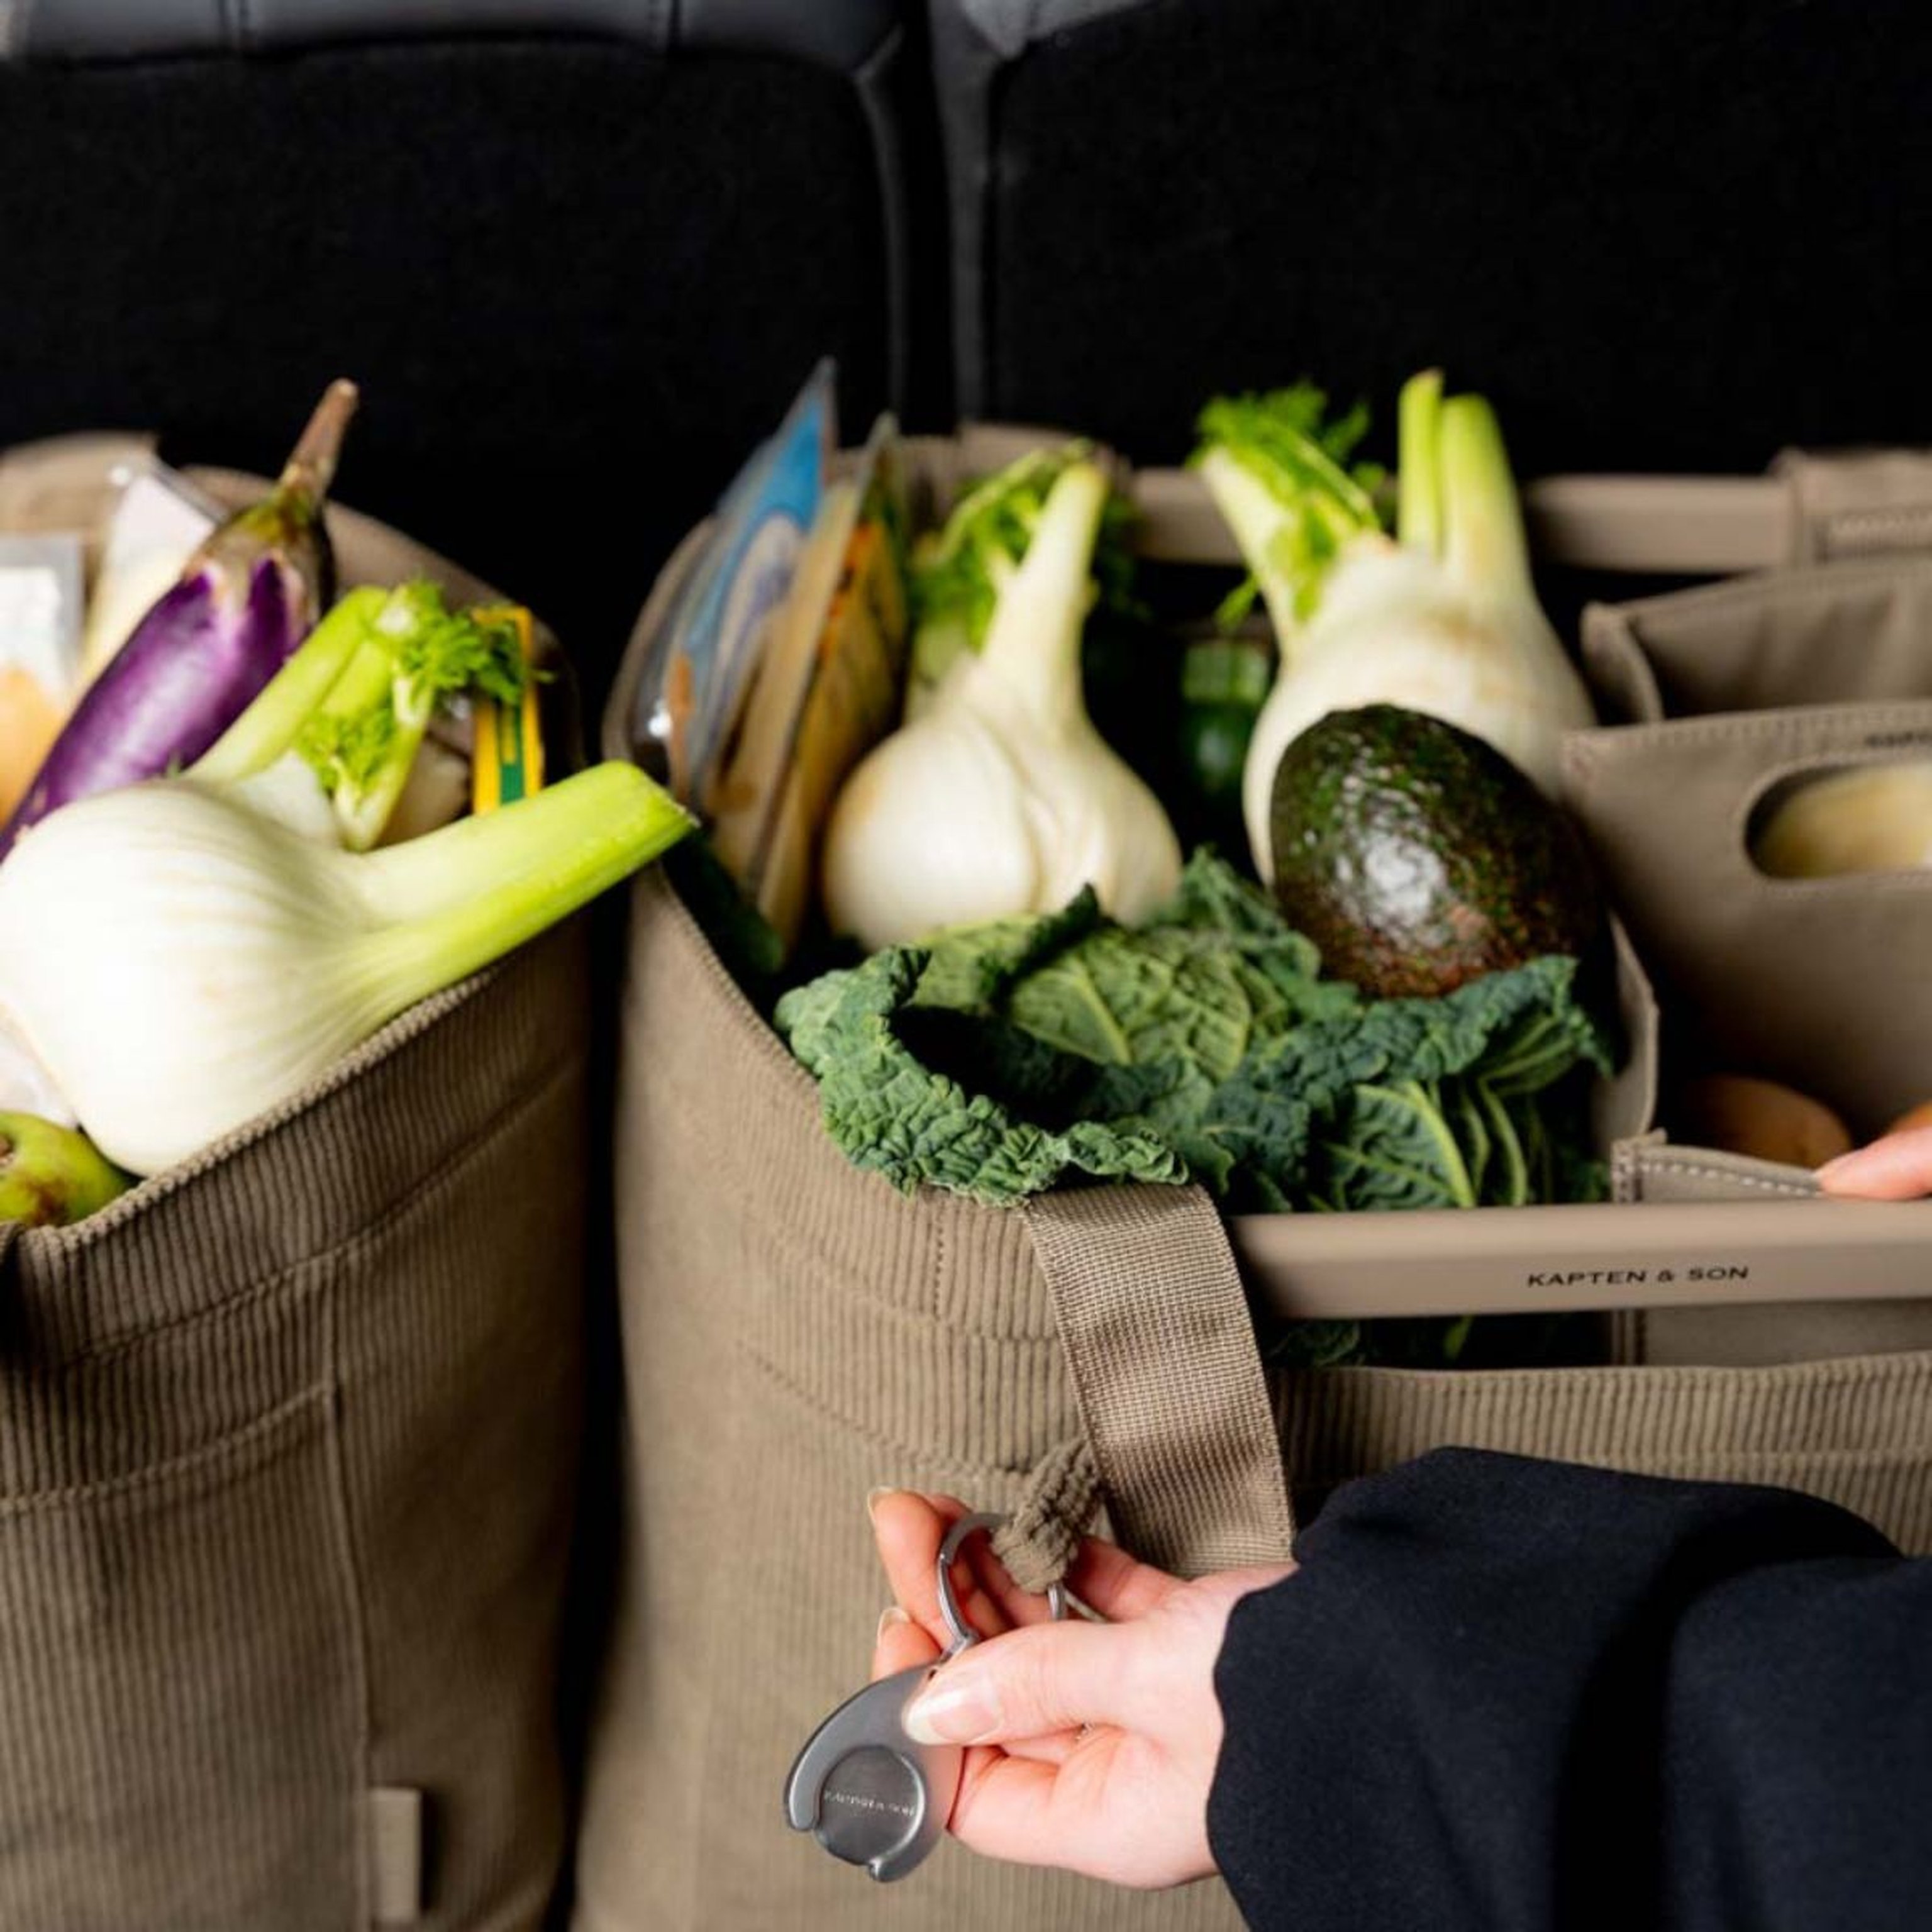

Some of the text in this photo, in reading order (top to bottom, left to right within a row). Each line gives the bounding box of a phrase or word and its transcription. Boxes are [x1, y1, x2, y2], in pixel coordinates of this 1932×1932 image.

[1528, 1266, 1749, 1287] KAPTEN & SON
